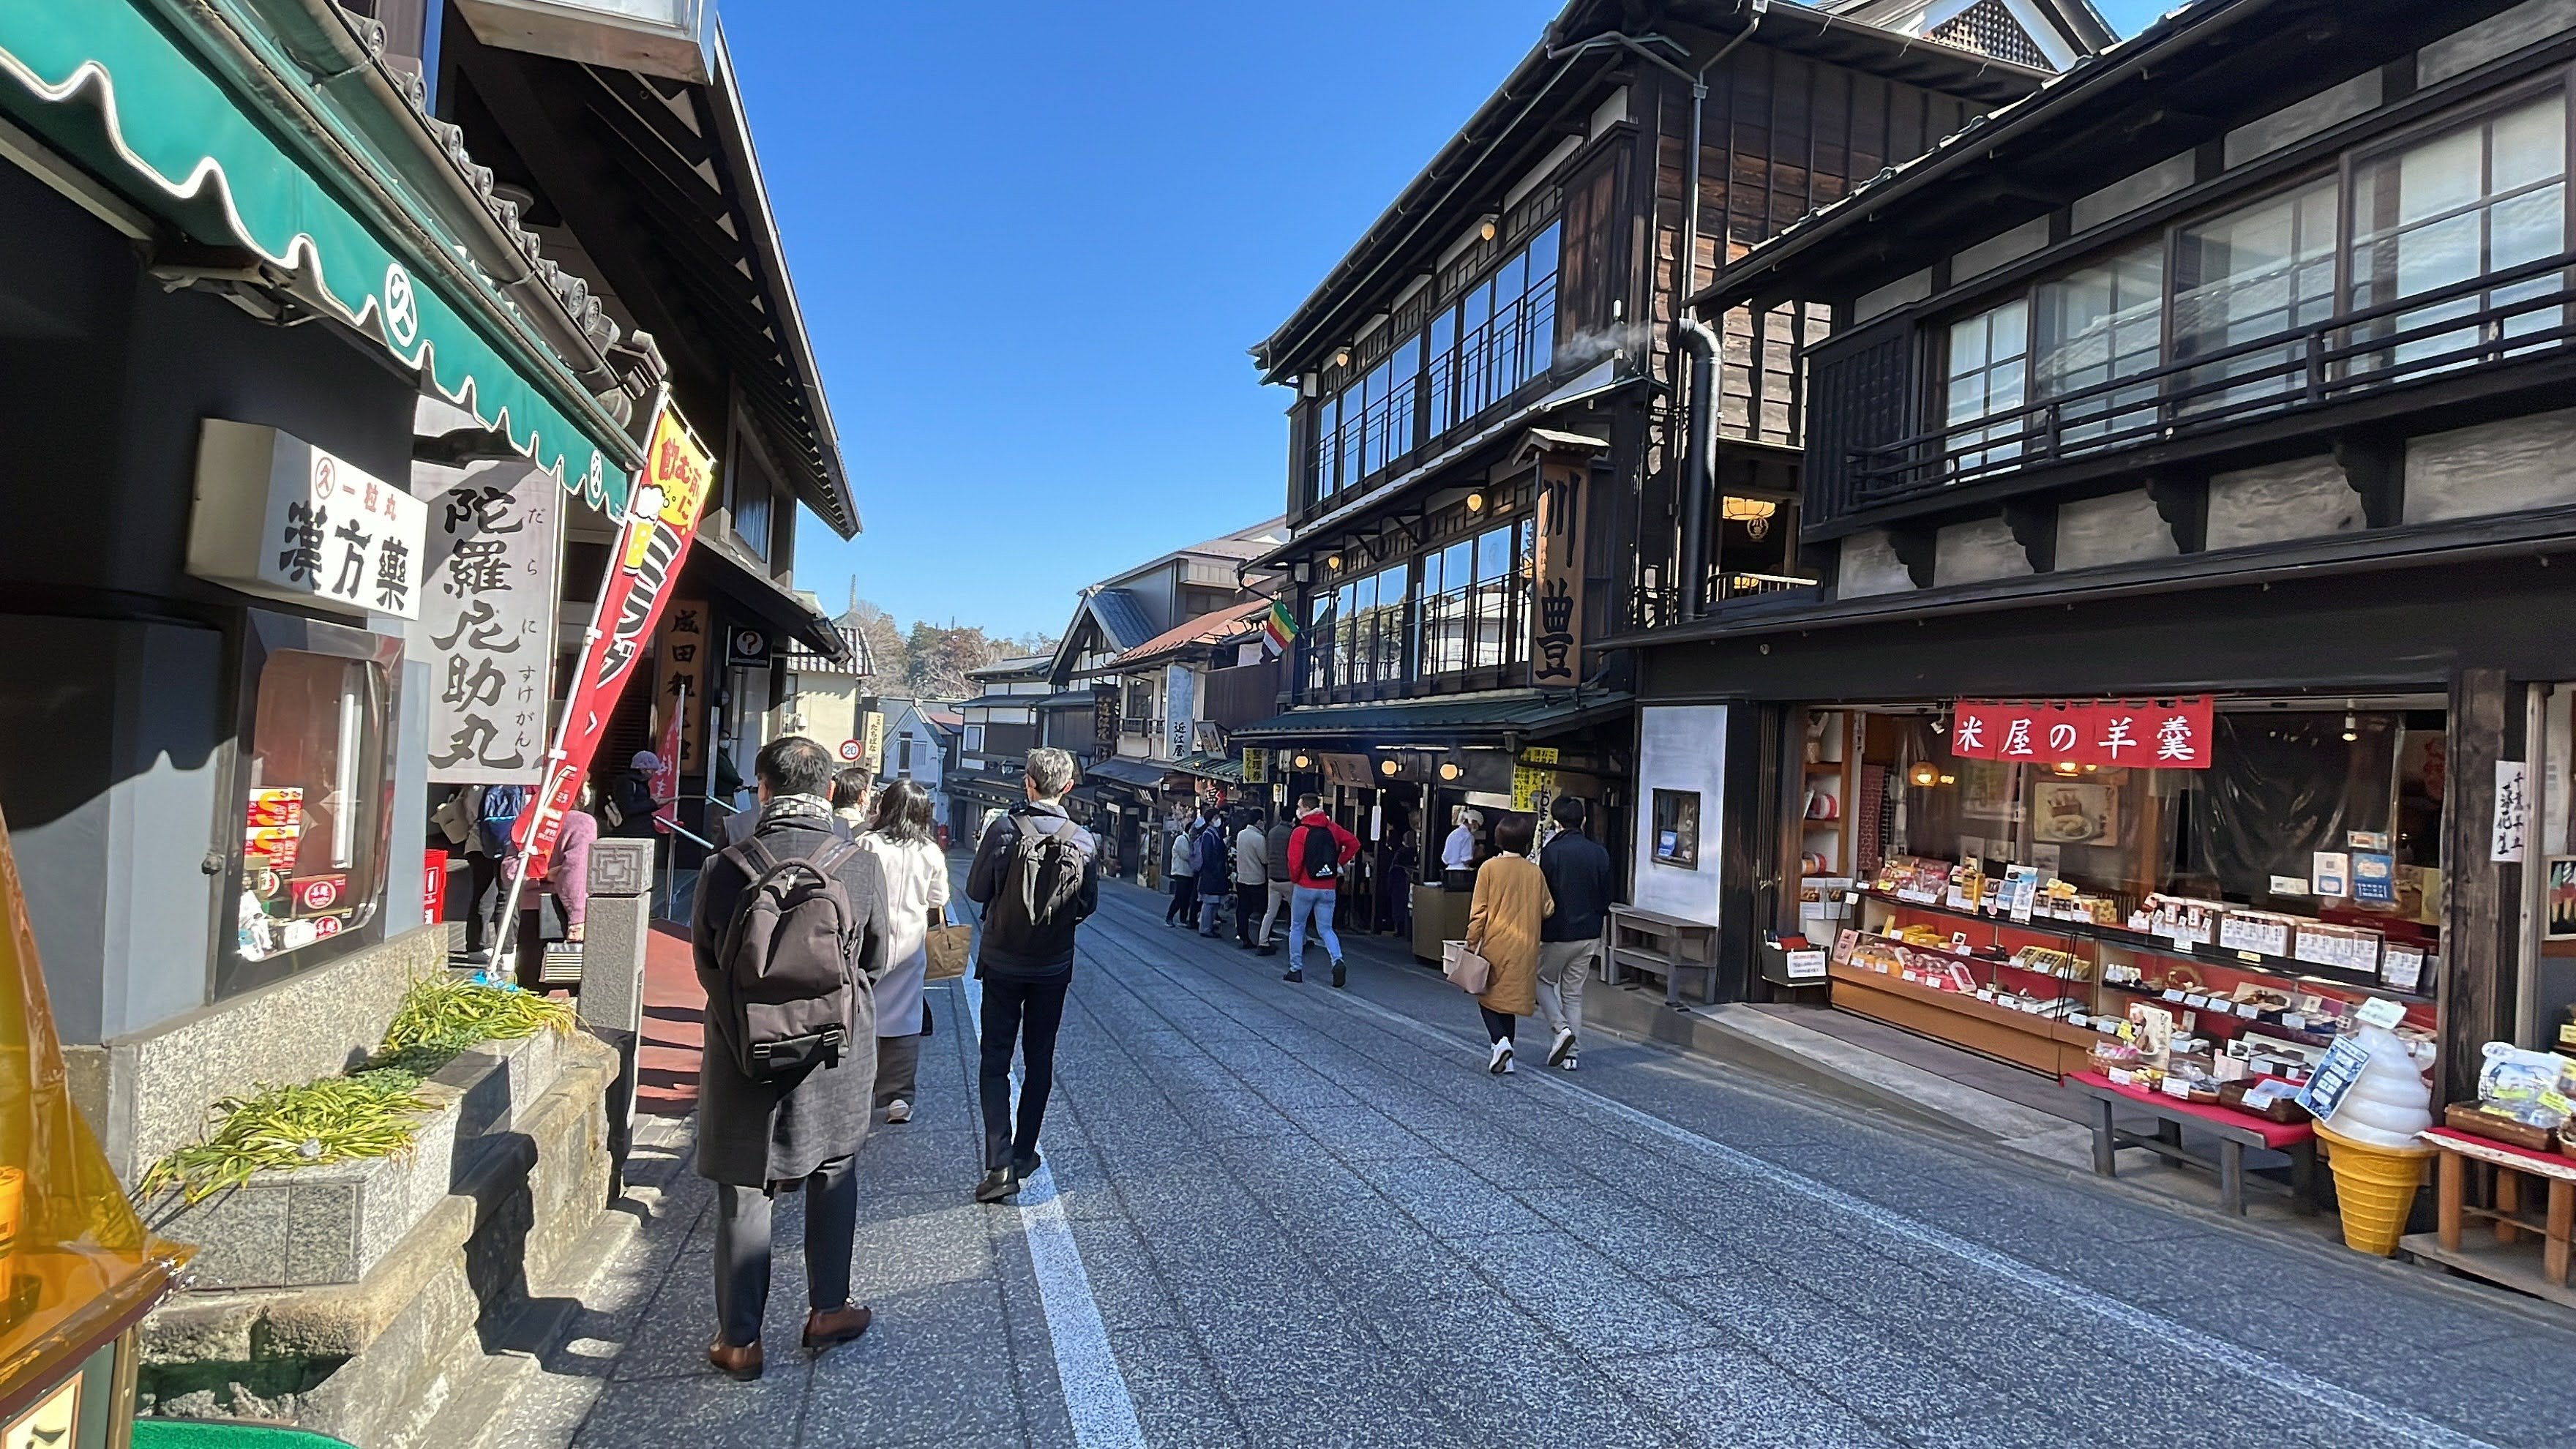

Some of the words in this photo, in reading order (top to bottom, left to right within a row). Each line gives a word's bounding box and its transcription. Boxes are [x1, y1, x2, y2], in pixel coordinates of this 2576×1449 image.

[342, 482, 396, 521] 一粒丸
[1535, 470, 1581, 680] 川豊
[428, 486, 524, 770] 陀羅尼助丸
[845, 745, 857, 755] 20
[869, 724, 877, 752] たちばな
[1172, 722, 1186, 757] 近江屋
[1956, 715, 2195, 761] 米屋の羊羹
